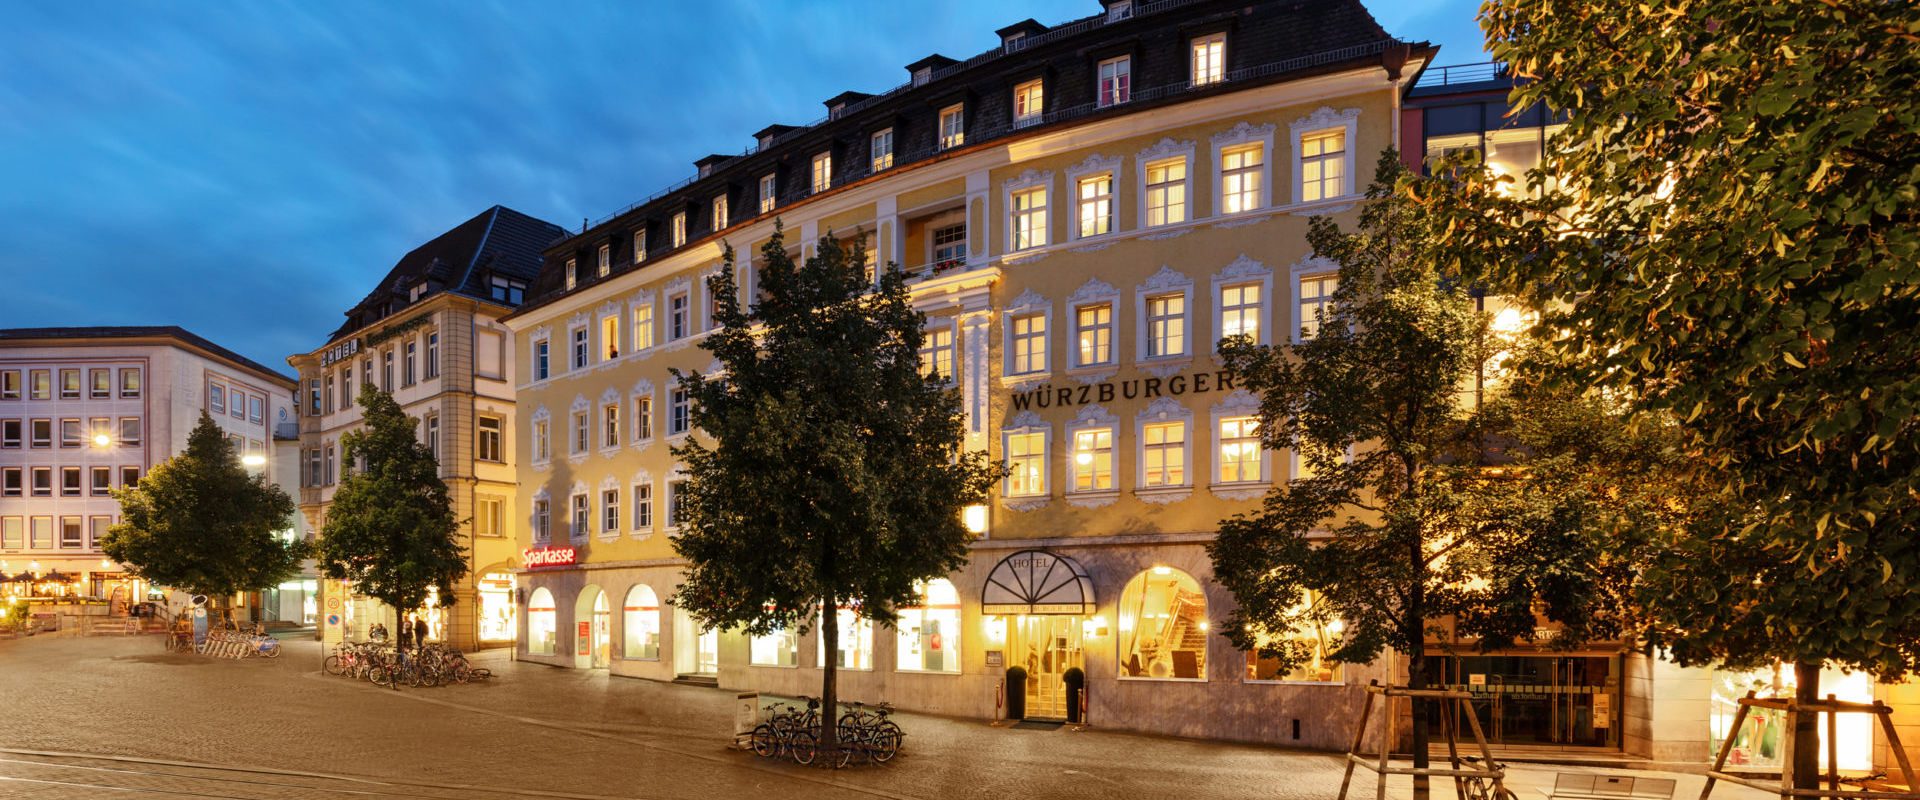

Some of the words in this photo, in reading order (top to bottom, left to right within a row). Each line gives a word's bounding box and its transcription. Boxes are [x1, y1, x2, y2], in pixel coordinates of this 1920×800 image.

[320, 338, 358, 367] HOTEL
[1011, 371, 1235, 411] WÜRZBURGER
[522, 546, 575, 568] Sparkasse
